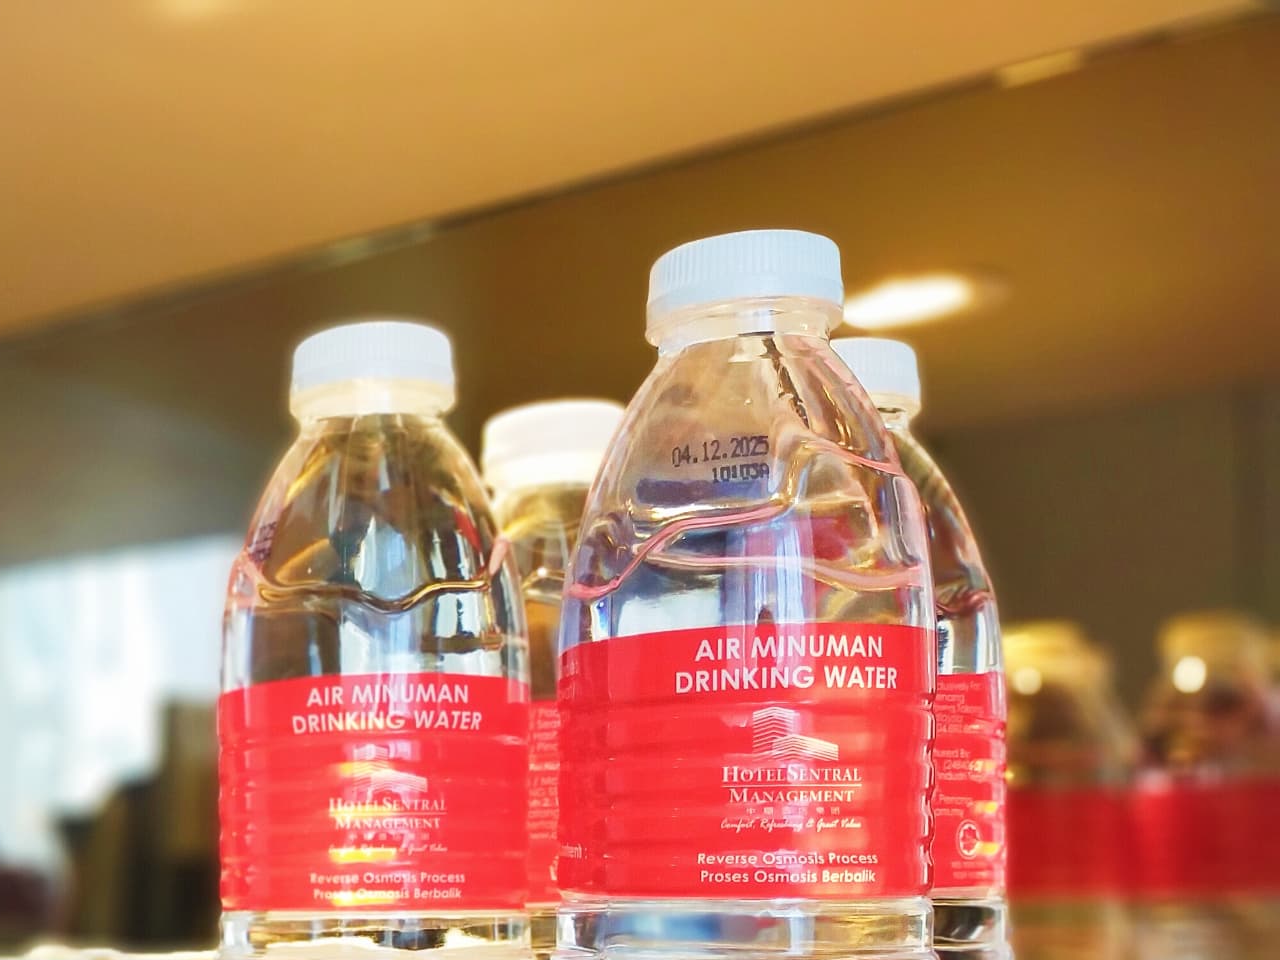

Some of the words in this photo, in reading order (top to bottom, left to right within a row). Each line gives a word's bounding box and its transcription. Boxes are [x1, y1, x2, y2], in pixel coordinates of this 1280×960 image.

[671, 435, 769, 468] 04.12.2025
[694, 638, 741, 662] AIR
[751, 635, 883, 658] MINUMAN
[675, 665, 815, 694] DRINKING
[824, 665, 898, 690] WATER
[306, 686, 344, 707] AIR
[351, 683, 469, 704] MINUMAN
[291, 710, 406, 735] DRINKING
[414, 710, 482, 730] WATER
[729, 788, 855, 803] MANAGEMENT
[697, 853, 757, 865] Reverse
[762, 852, 825, 865] Osmosis
[828, 852, 878, 864] Process
[310, 873, 359, 884] Reverse
[363, 872, 417, 884] Osmosis
[420, 871, 466, 883] Process
[700, 871, 749, 883] Proses
[754, 870, 818, 883] Osmosis
[822, 869, 876, 883] Berbalik
[414, 887, 462, 899] Berbalik
